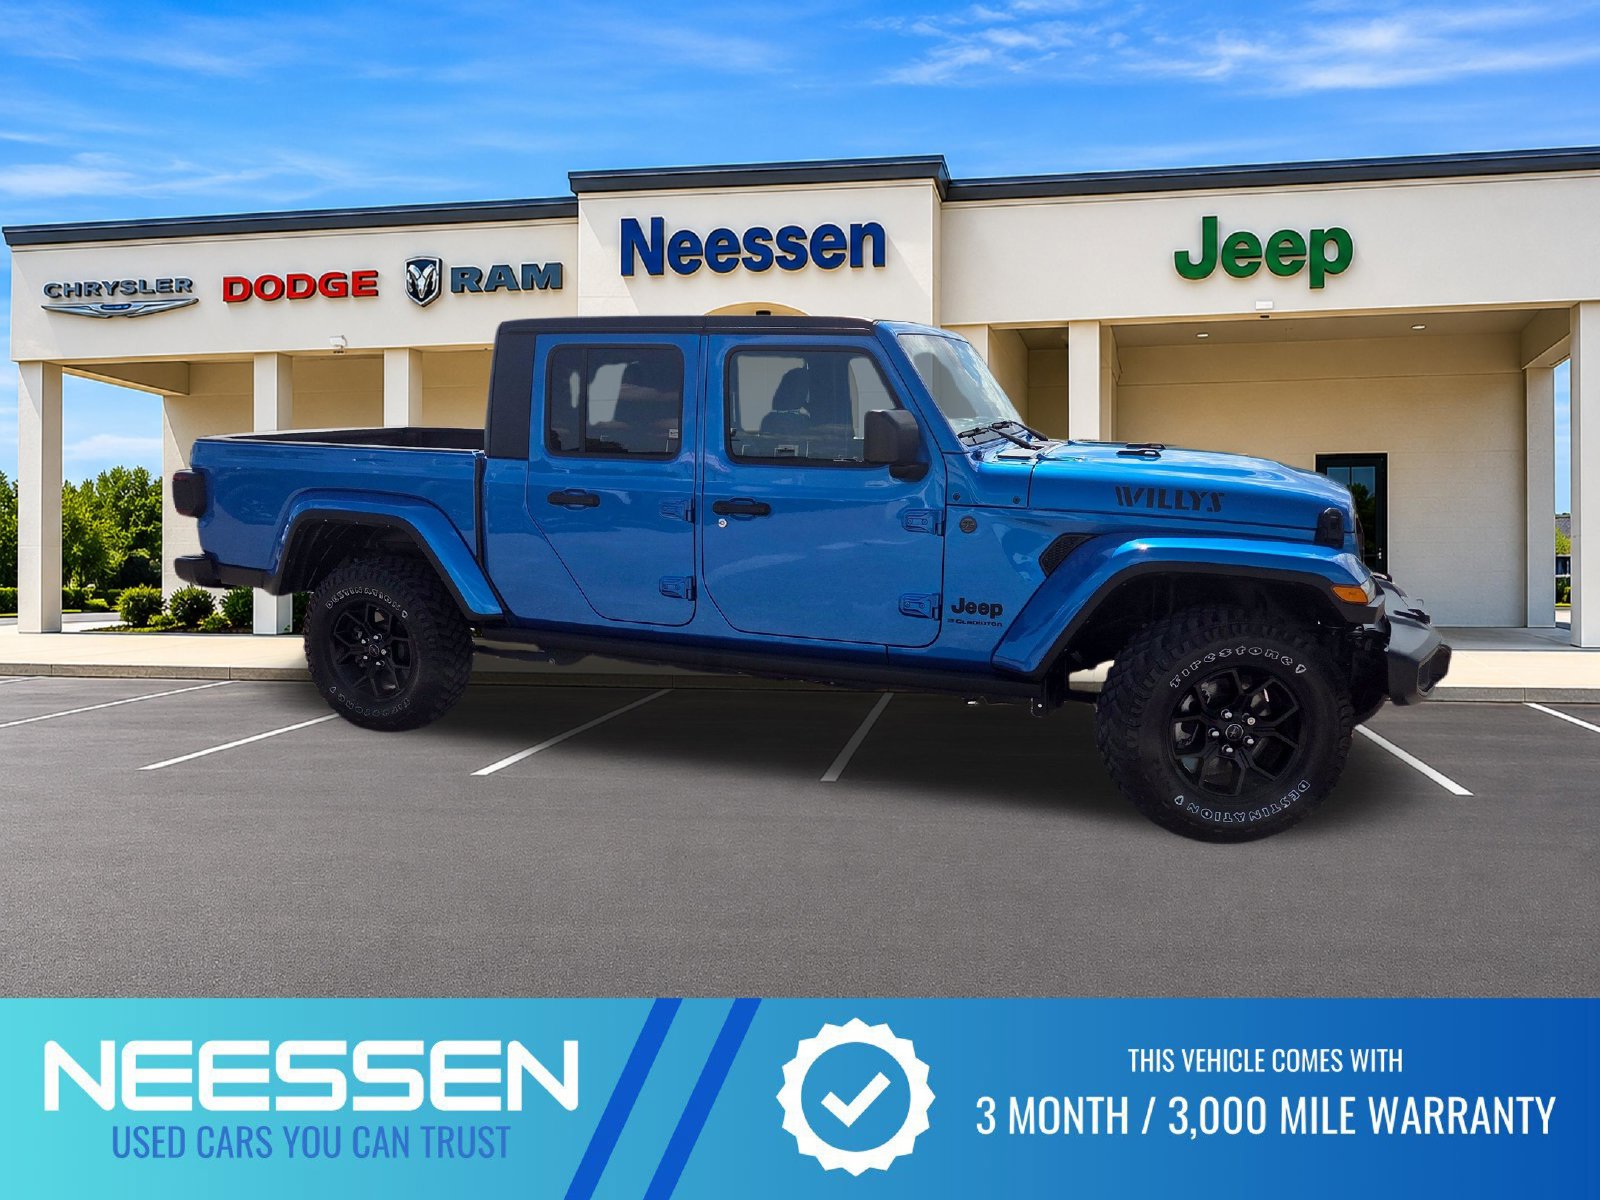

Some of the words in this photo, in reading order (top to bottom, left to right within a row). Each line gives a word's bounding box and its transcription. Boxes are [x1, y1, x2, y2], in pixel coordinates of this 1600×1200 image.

[620, 216, 887, 277] Neessen
[1174, 215, 1354, 290] Jeep
[43, 277, 194, 299] CHRYSLER
[222, 270, 379, 304] DODGE
[450, 262, 565, 294] RAM
[1115, 486, 1225, 512] WILLYS
[951, 597, 1004, 619] Jeep
[955, 618, 1003, 628] GLADIATOR
[1187, 780, 1311, 823] DESTINATION
